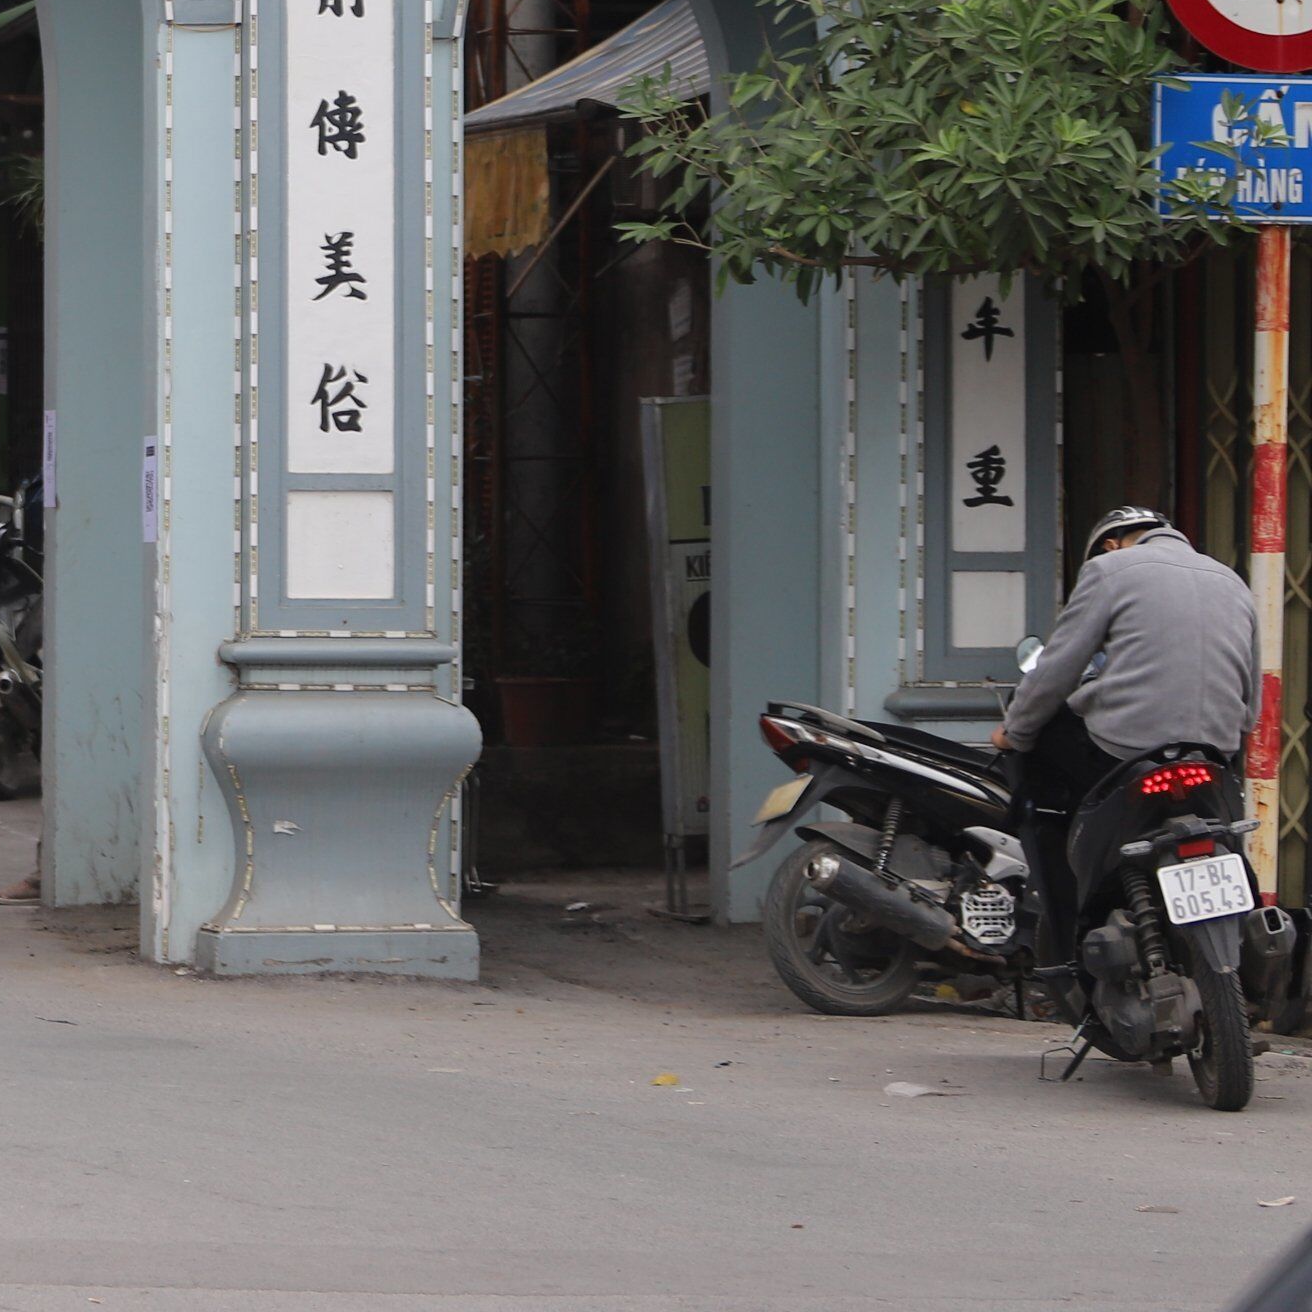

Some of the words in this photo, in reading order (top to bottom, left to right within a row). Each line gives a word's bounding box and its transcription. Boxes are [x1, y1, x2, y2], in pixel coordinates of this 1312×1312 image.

[1237, 157, 1304, 204] HÀNG
[1173, 861, 1233, 894] 17-B4
[1172, 884, 1249, 920] 605.43
